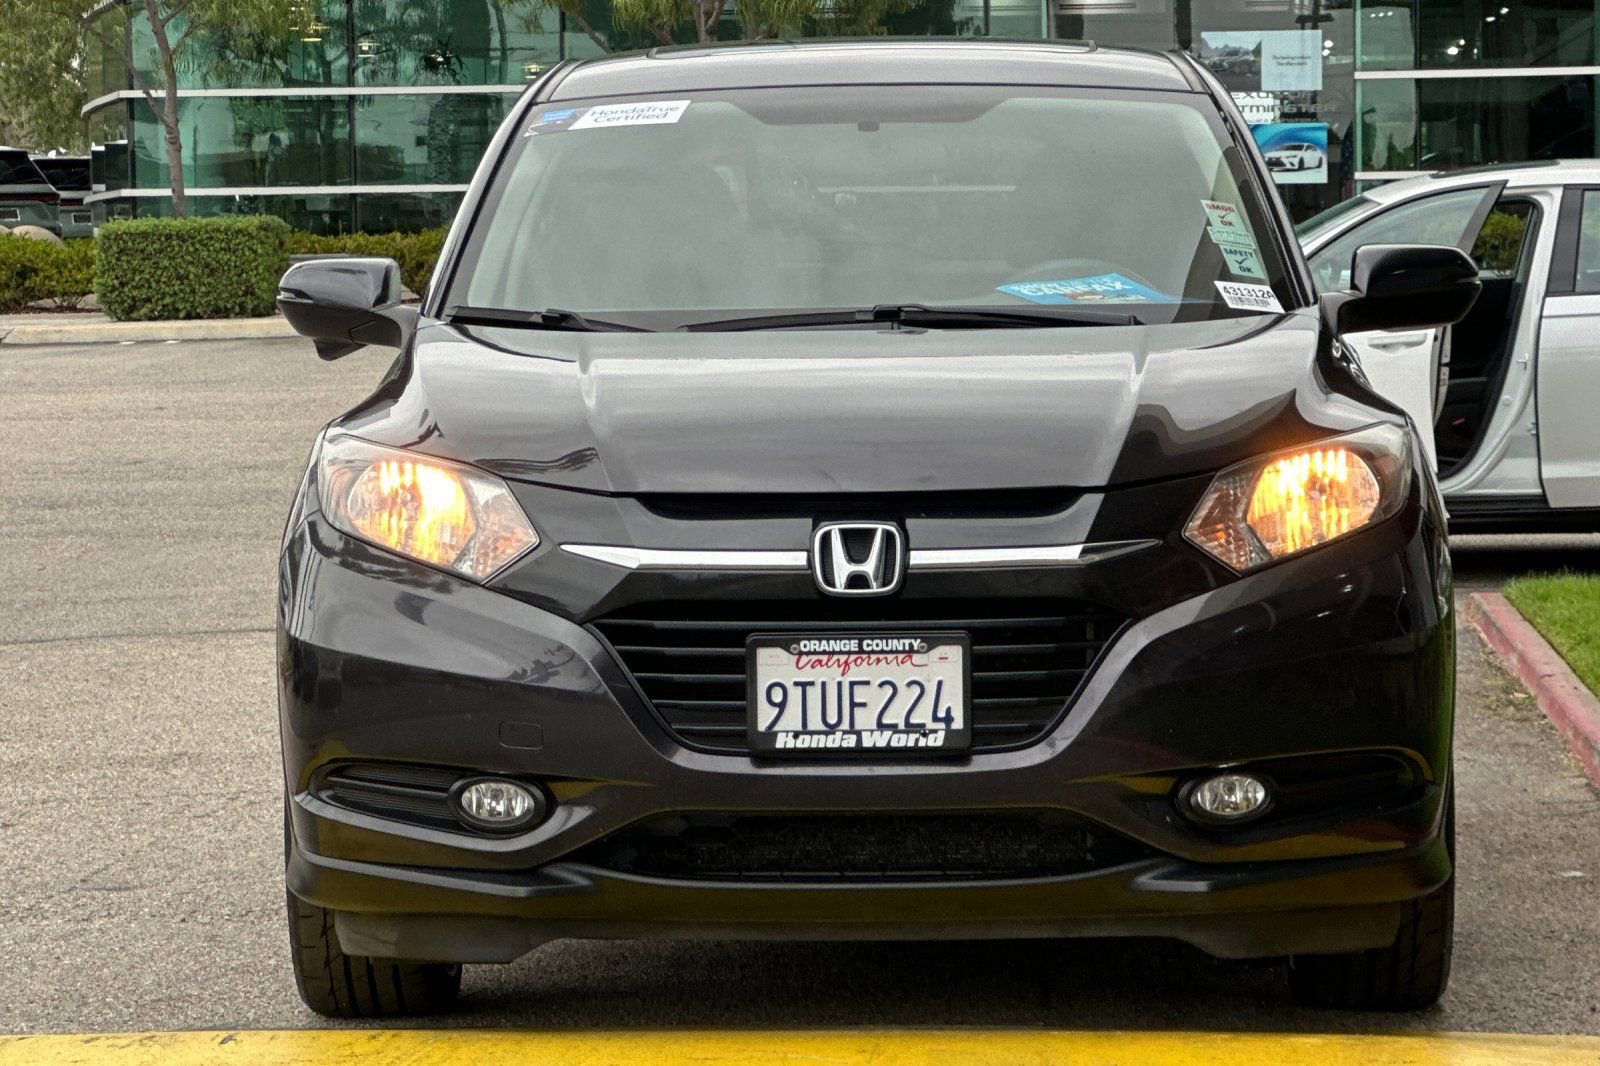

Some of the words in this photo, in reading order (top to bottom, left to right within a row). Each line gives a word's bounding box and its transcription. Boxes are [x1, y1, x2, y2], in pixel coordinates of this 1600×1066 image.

[1230, 91, 1282, 99] EXUS
[590, 105, 680, 117] HondaTrue
[1240, 104, 1336, 113] TMINSTER
[593, 112, 669, 123] Certified
[1223, 248, 1254, 258] SAFETY
[1239, 265, 1254, 274] OK
[1223, 285, 1276, 300] 431312A
[800, 639, 859, 652] ORANGE
[862, 638, 922, 652] COUNTY
[793, 652, 928, 677] California
[764, 679, 955, 731] 9TUF224
[775, 731, 857, 748] Honda
